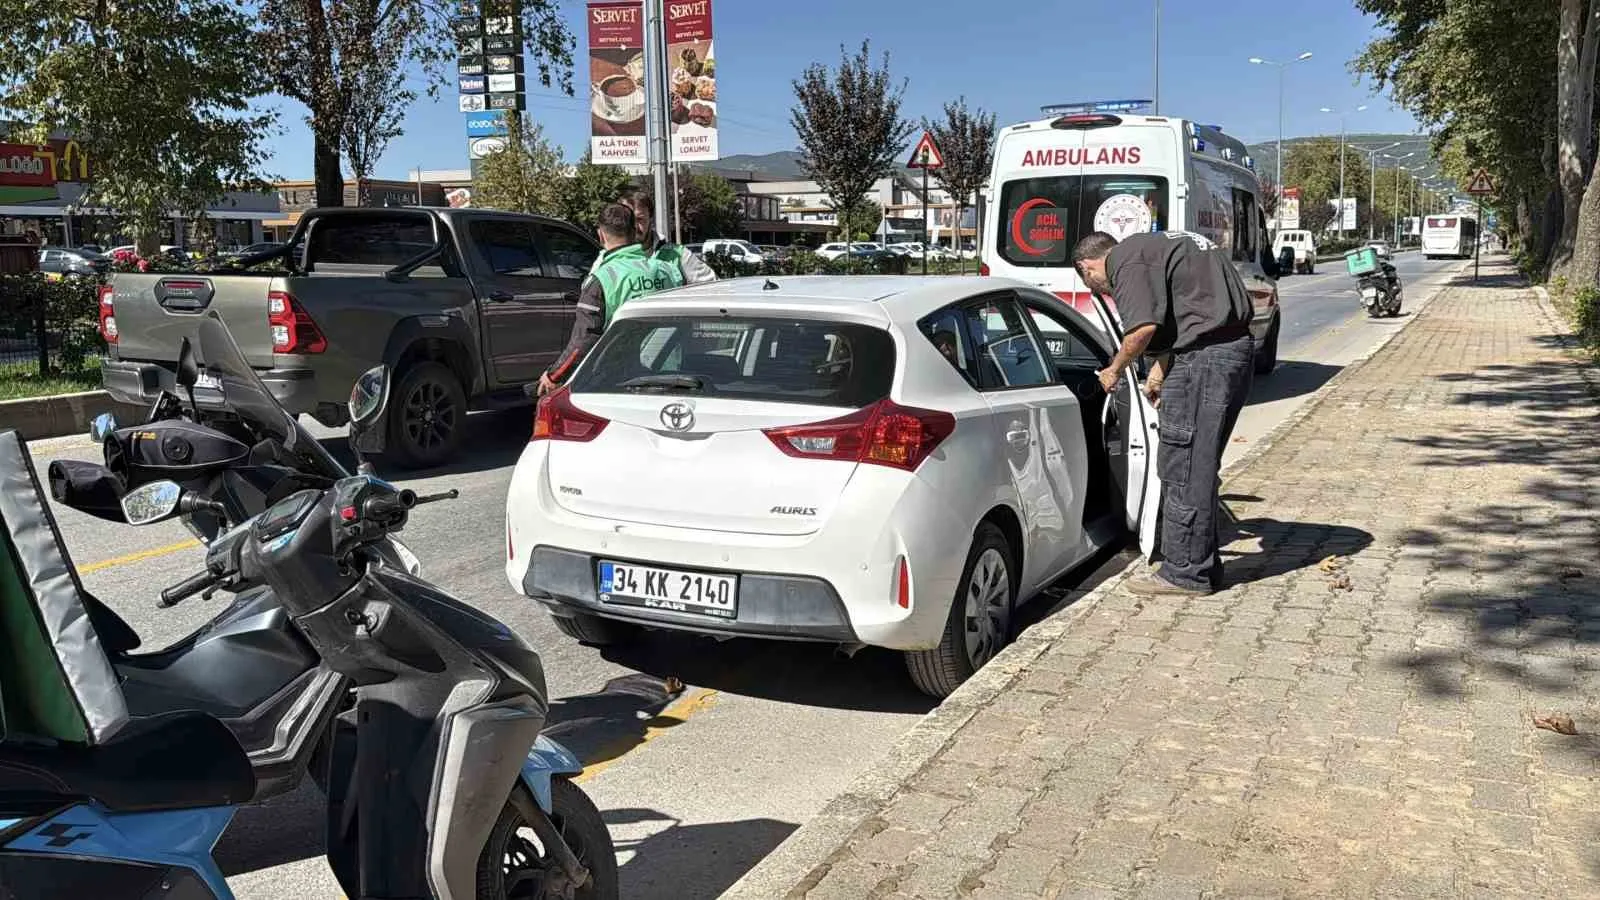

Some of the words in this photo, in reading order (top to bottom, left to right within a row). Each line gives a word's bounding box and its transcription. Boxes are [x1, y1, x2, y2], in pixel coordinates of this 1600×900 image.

[593, 8, 637, 24] SERVET
[670, 1, 707, 20] SERVET
[681, 136, 708, 144] SERVET
[680, 146, 710, 154] LOKUMU
[1022, 147, 1141, 167] AMBULANS
[629, 276, 666, 292] Uber
[559, 485, 583, 496] TOYOTA
[769, 505, 817, 516] AURIS
[614, 567, 638, 593] 34
[644, 570, 670, 598] KK
[679, 574, 729, 605] 2140
